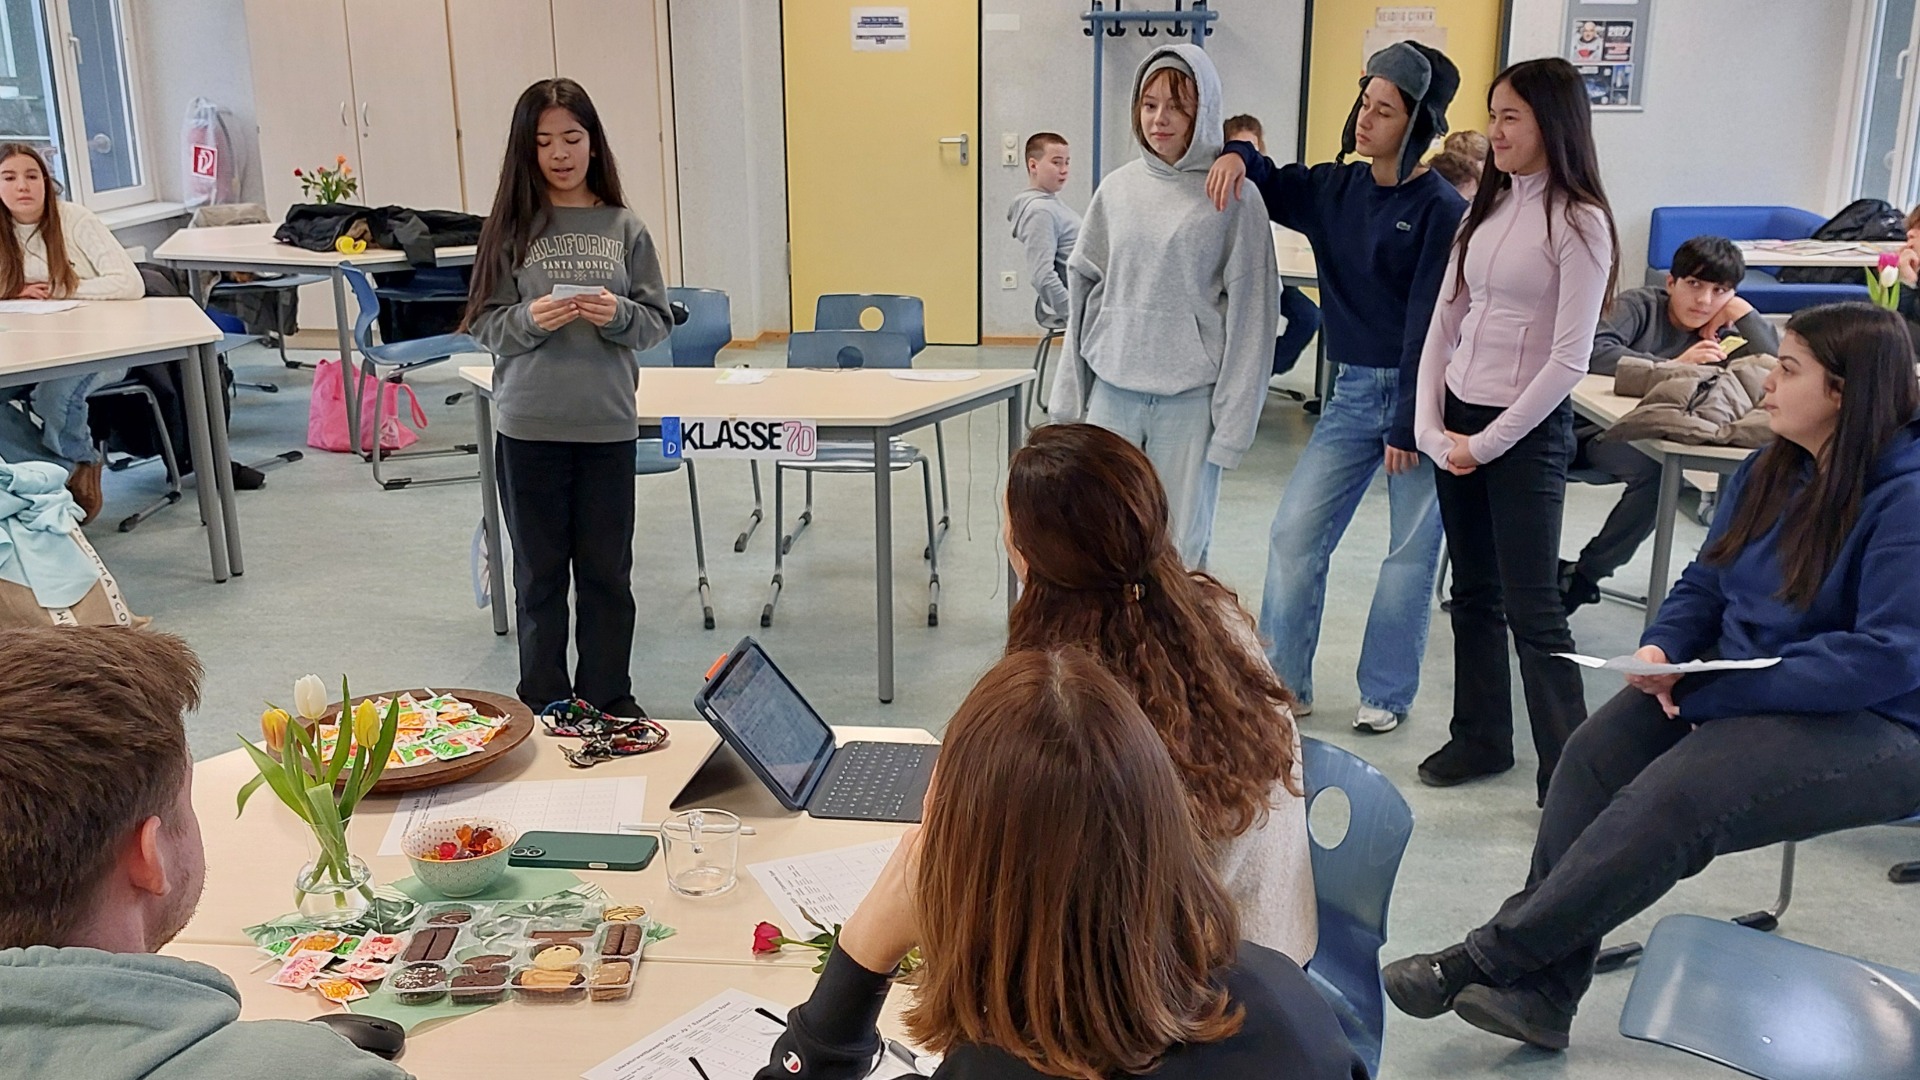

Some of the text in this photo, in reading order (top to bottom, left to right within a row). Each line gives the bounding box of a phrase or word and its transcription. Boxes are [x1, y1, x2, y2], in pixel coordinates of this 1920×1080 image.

[542, 260, 615, 271] SANTA MONICA
[547, 270, 613, 280] GRAD TEAM
[681, 420, 782, 450] KLASSE
